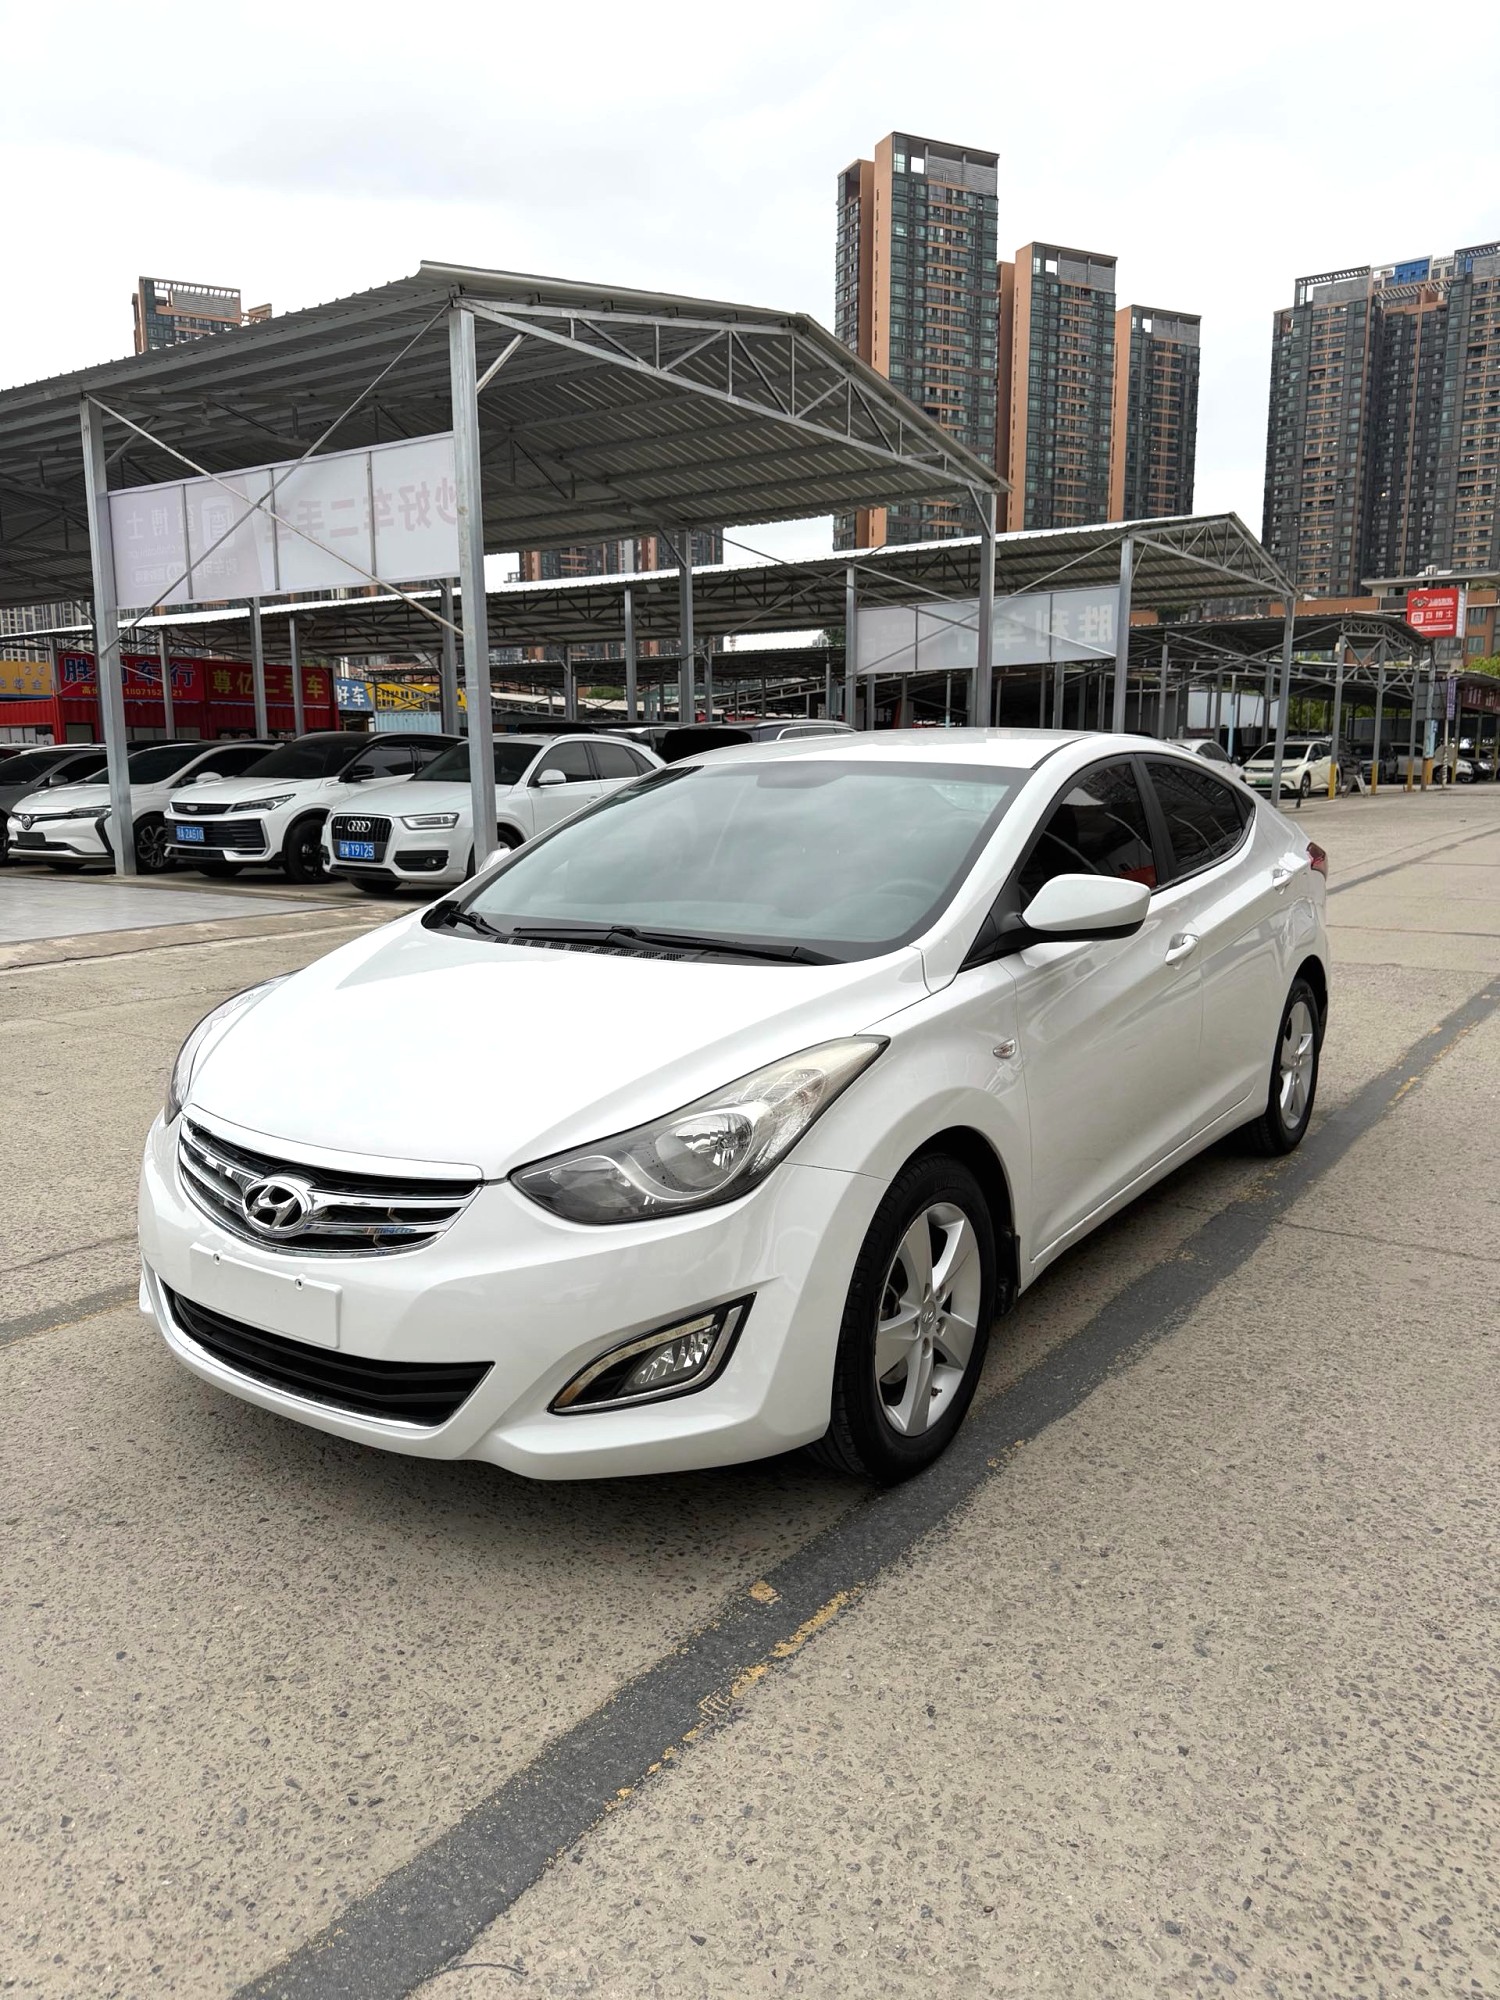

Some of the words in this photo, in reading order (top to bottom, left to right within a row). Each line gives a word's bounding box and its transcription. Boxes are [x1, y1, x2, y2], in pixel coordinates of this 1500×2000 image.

[64, 656, 195, 688] 胜车行
[126, 688, 183, 697] 180715221
